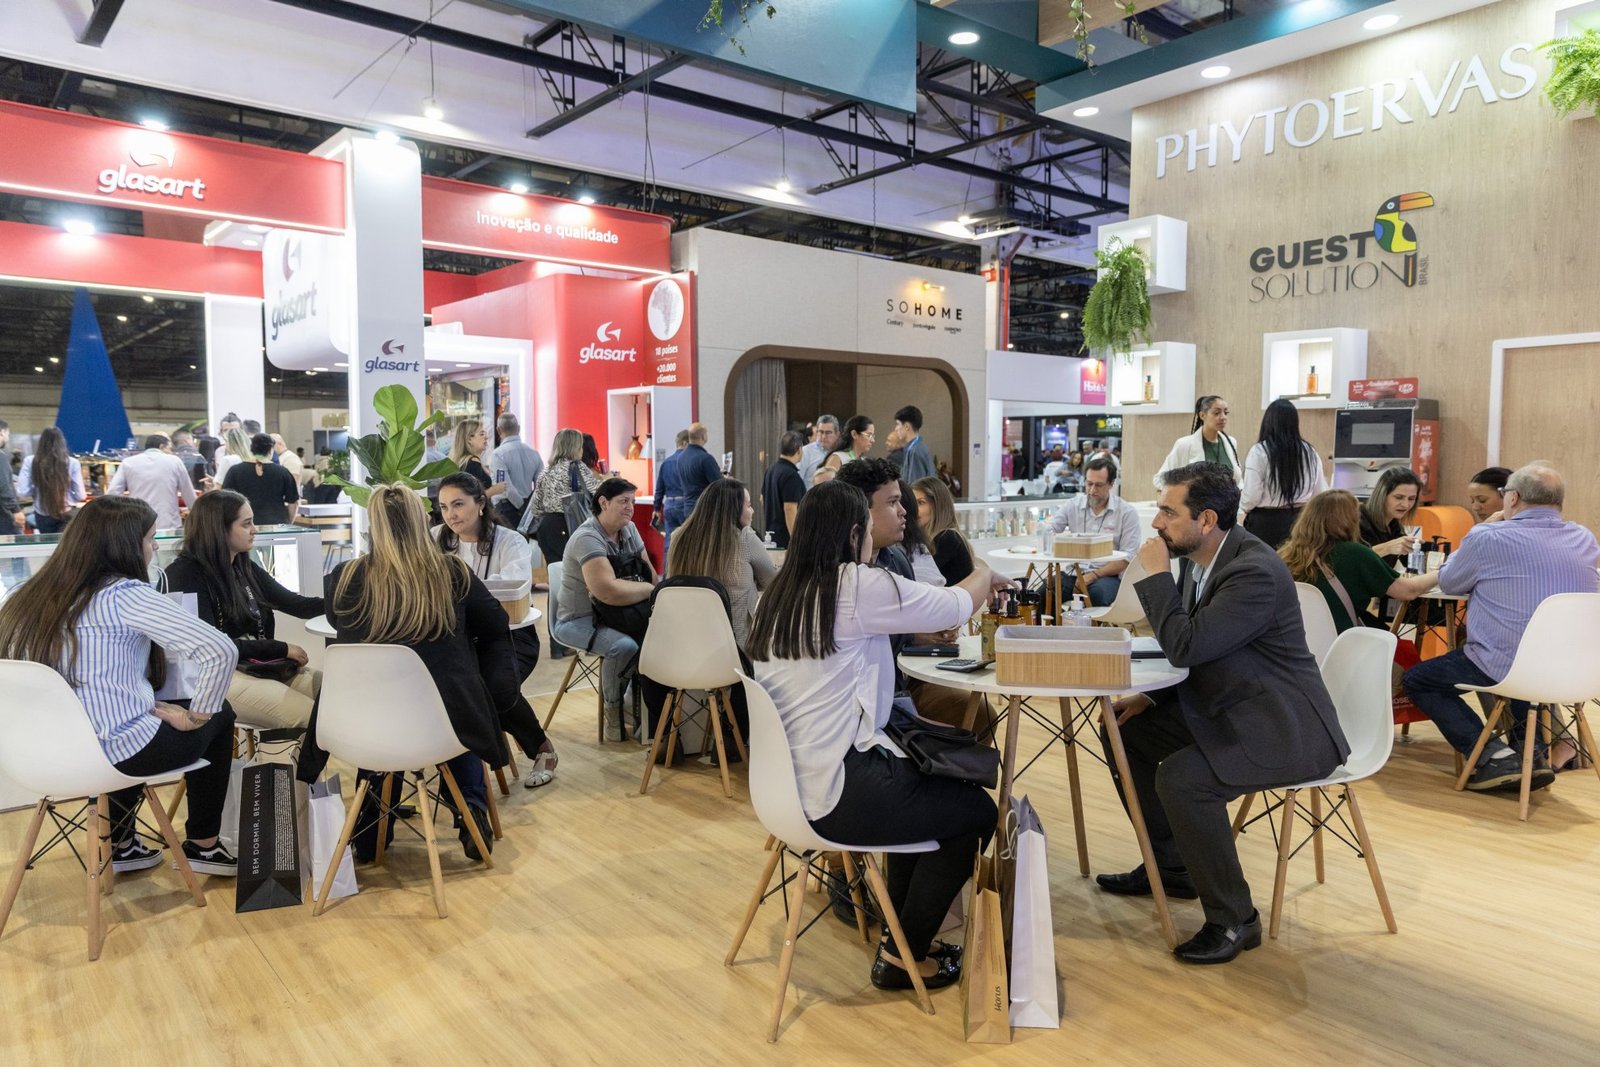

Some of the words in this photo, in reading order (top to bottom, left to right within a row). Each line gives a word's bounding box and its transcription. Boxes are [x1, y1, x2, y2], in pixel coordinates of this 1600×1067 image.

[1155, 43, 1538, 179] PHYTOERVAS
[99, 164, 206, 198] glasart
[476, 210, 541, 233] Inovação
[544, 224, 553, 235] e
[556, 225, 619, 245] qualidade
[1250, 230, 1375, 273] GUEST
[1249, 252, 1418, 304] SOLUTION
[1418, 254, 1430, 286] BRASIL
[271, 281, 318, 341] glasart
[364, 356, 420, 374] glasart
[579, 342, 637, 364] glasart
[656, 374, 677, 383] clientes
[252, 819, 261, 855] DORMIR,
[993, 985, 1001, 1012] Horus
